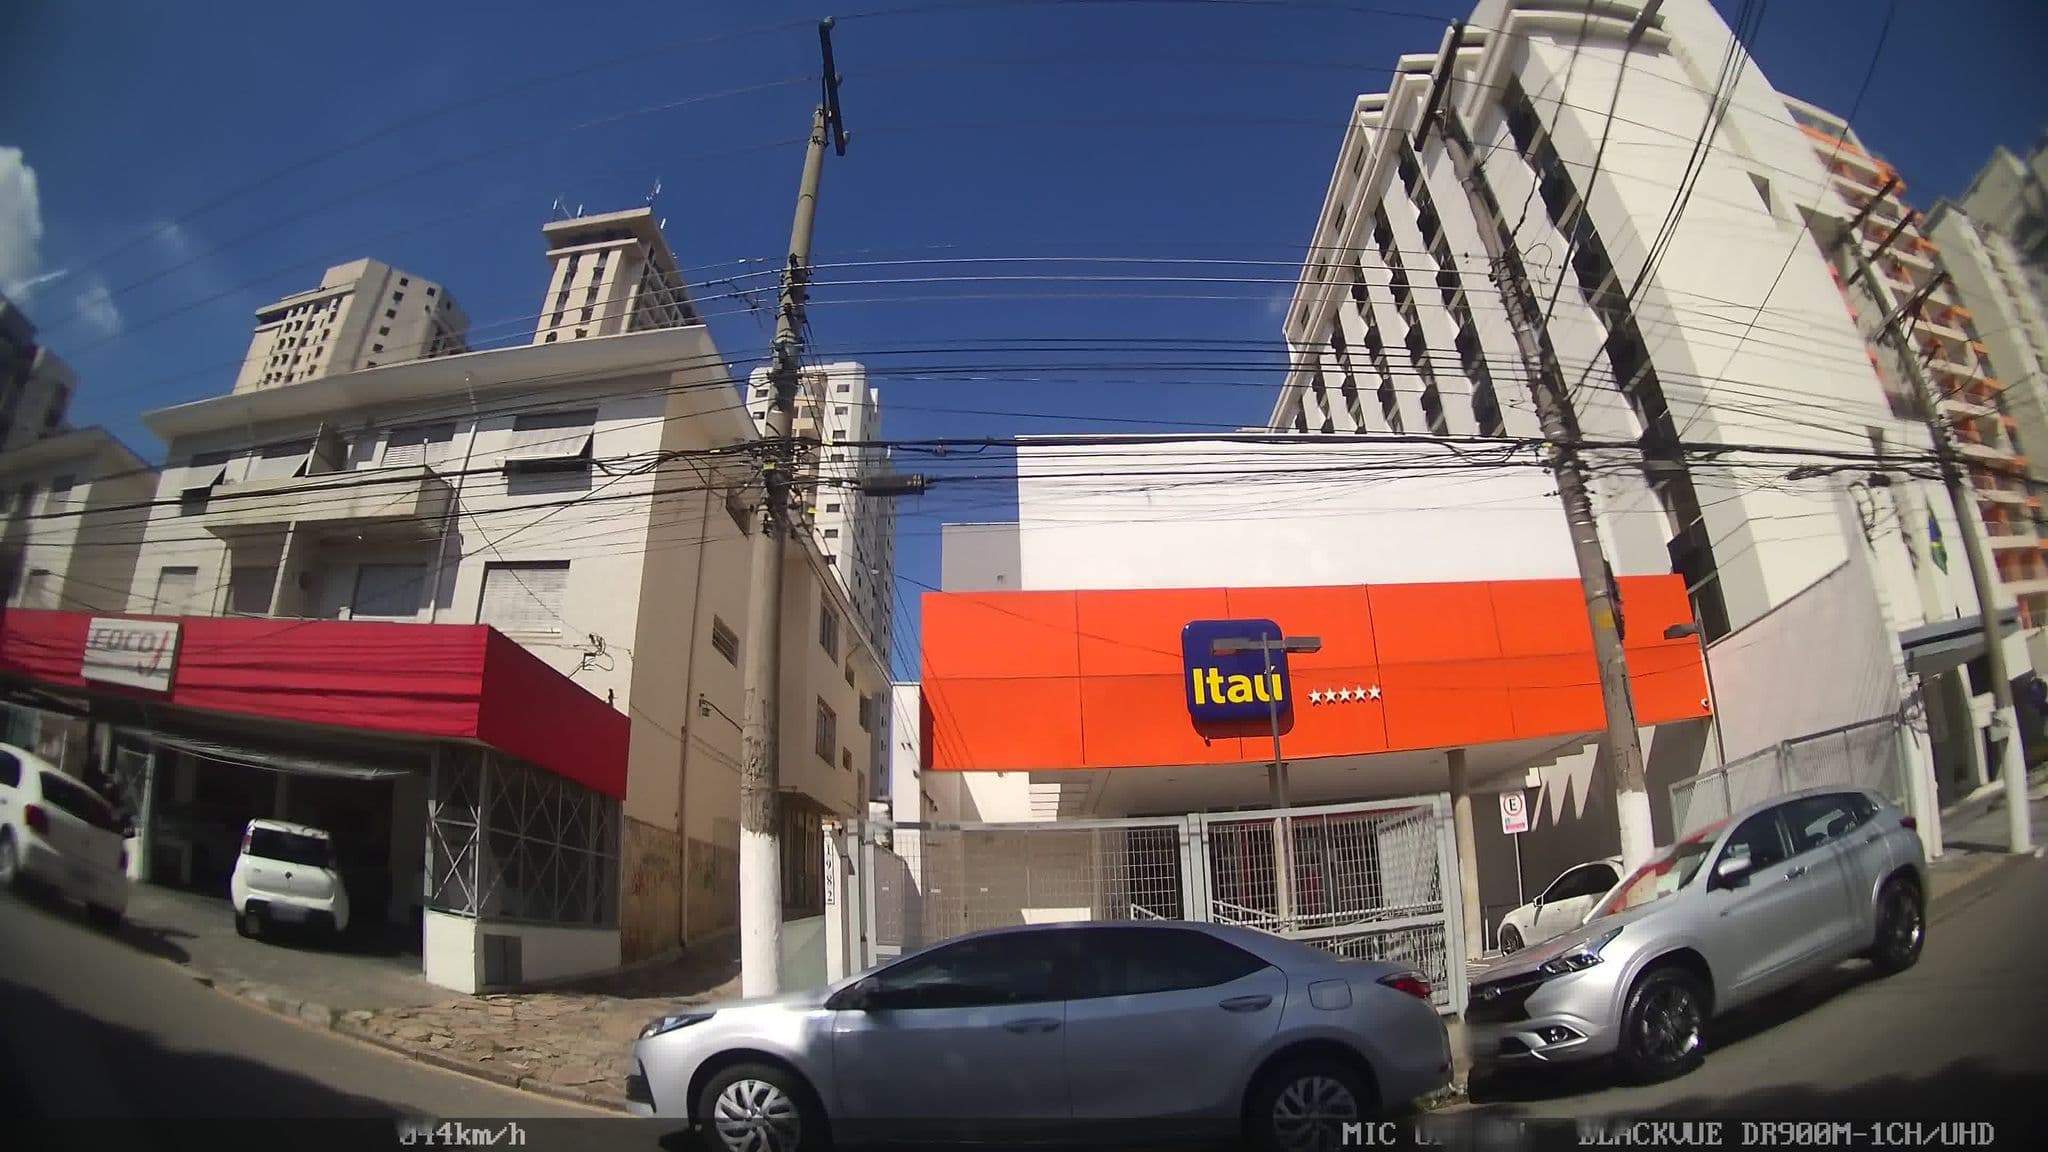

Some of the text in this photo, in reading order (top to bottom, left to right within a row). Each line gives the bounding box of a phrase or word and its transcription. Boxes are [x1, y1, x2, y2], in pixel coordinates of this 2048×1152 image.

[1192, 665, 1284, 705] Itaú
[1508, 797, 1518, 812] E
[825, 844, 833, 902] 1982
